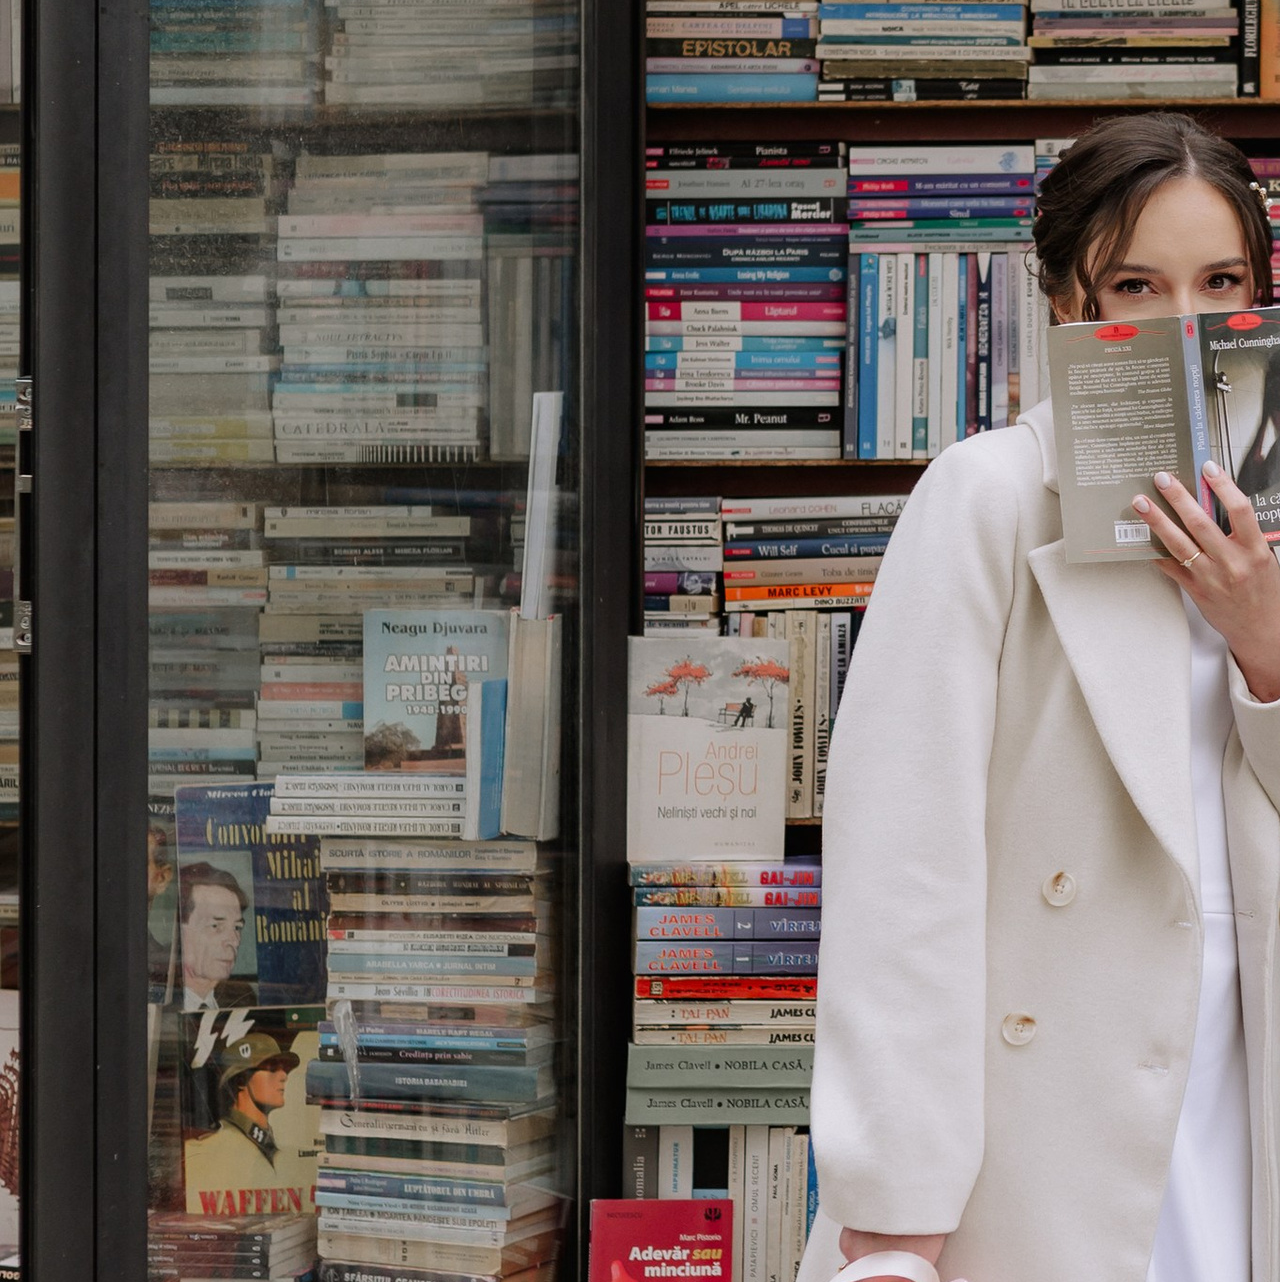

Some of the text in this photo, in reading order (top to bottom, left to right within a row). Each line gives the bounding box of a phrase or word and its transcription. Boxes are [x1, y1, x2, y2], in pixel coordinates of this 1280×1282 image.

[681, 40, 792, 57] EPISTOLAR
[1209, 338, 1237, 351] Michael
[735, 413, 788, 425] Mr. Peanut
[1256, 494, 1266, 506] la
[668, 523, 710, 535] FAUSTUS
[758, 544, 778, 557] Will
[780, 544, 798, 556] Self
[767, 586, 833, 598] MARC LEVY
[381, 621, 489, 639] Neagu Djuvara
[384, 654, 489, 672] AMINTIRI
[420, 671, 452, 685] DIN
[704, 740, 759, 759] Andrei
[791, 755, 803, 784] JOHN
[700, 805, 727, 819] vechi
[741, 806, 757, 818] noi
[659, 913, 716, 925] JAMES
[649, 926, 723, 938] CLAVELL
[658, 948, 715, 959] JAMES
[647, 960, 722, 972] CLAVELL
[645, 1060, 675, 1071] James
[677, 1059, 711, 1071] Clavell
[724, 1060, 768, 1071] NOBILA
[646, 1097, 677, 1109] James
[679, 1097, 713, 1109] Clavell
[726, 1097, 771, 1109] NOBILA
[199, 1188, 302, 1217] WAFFEN
[629, 1246, 723, 1261] Adevăr sau
[644, 1262, 722, 1277] minciună
